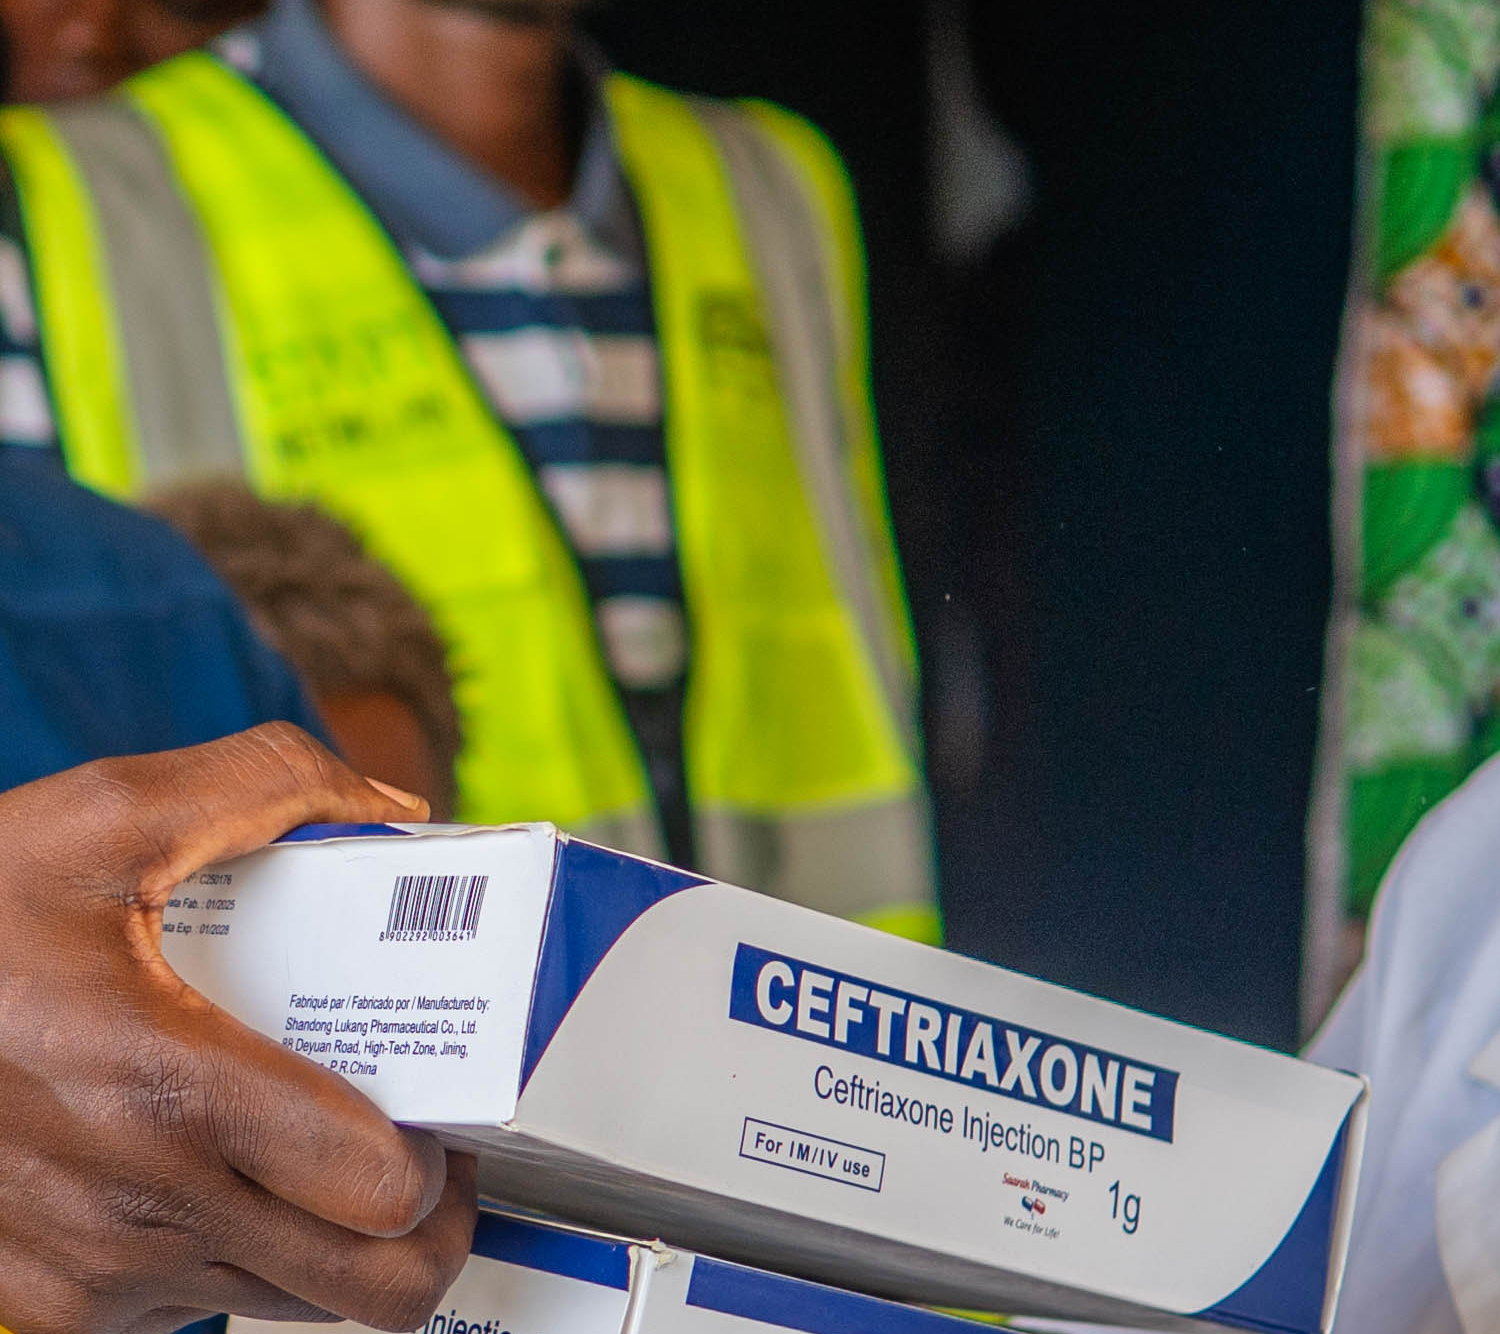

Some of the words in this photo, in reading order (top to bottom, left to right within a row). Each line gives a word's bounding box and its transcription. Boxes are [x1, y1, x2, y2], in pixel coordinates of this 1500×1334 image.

[205, 898, 236, 910] 01/2025
[289, 994, 329, 1011] Fabriqué
[329, 999, 345, 1012] par
[350, 995, 394, 1010] Fabricado
[394, 999, 410, 1013] por
[416, 996, 475, 1010] Manufactured
[475, 996, 490, 1014] by:
[284, 1017, 332, 1035] Shandong
[333, 1019, 369, 1036] Lukang
[369, 1019, 438, 1034] Pharmaceutical
[439, 1020, 459, 1035] Co.,
[460, 1020, 478, 1034] Ltd.
[295, 1038, 332, 1056] Deyuan
[333, 1040, 361, 1055] Road,
[362, 1040, 410, 1058] High-Tech
[412, 1041, 438, 1057] Zone,
[439, 1042, 469, 1059] Jining,
[755, 959, 1155, 1131] CEFTRIAXONE
[813, 1065, 954, 1134] Ceftriaxone
[962, 1106, 1060, 1164] Injection
[1070, 1136, 1105, 1174] BP
[754, 1131, 784, 1156] For
[788, 1139, 839, 1170] IM/IV
[842, 1156, 871, 1178] use
[1031, 1177, 1070, 1203] Pharmacy
[1107, 1179, 1142, 1234] 1g
